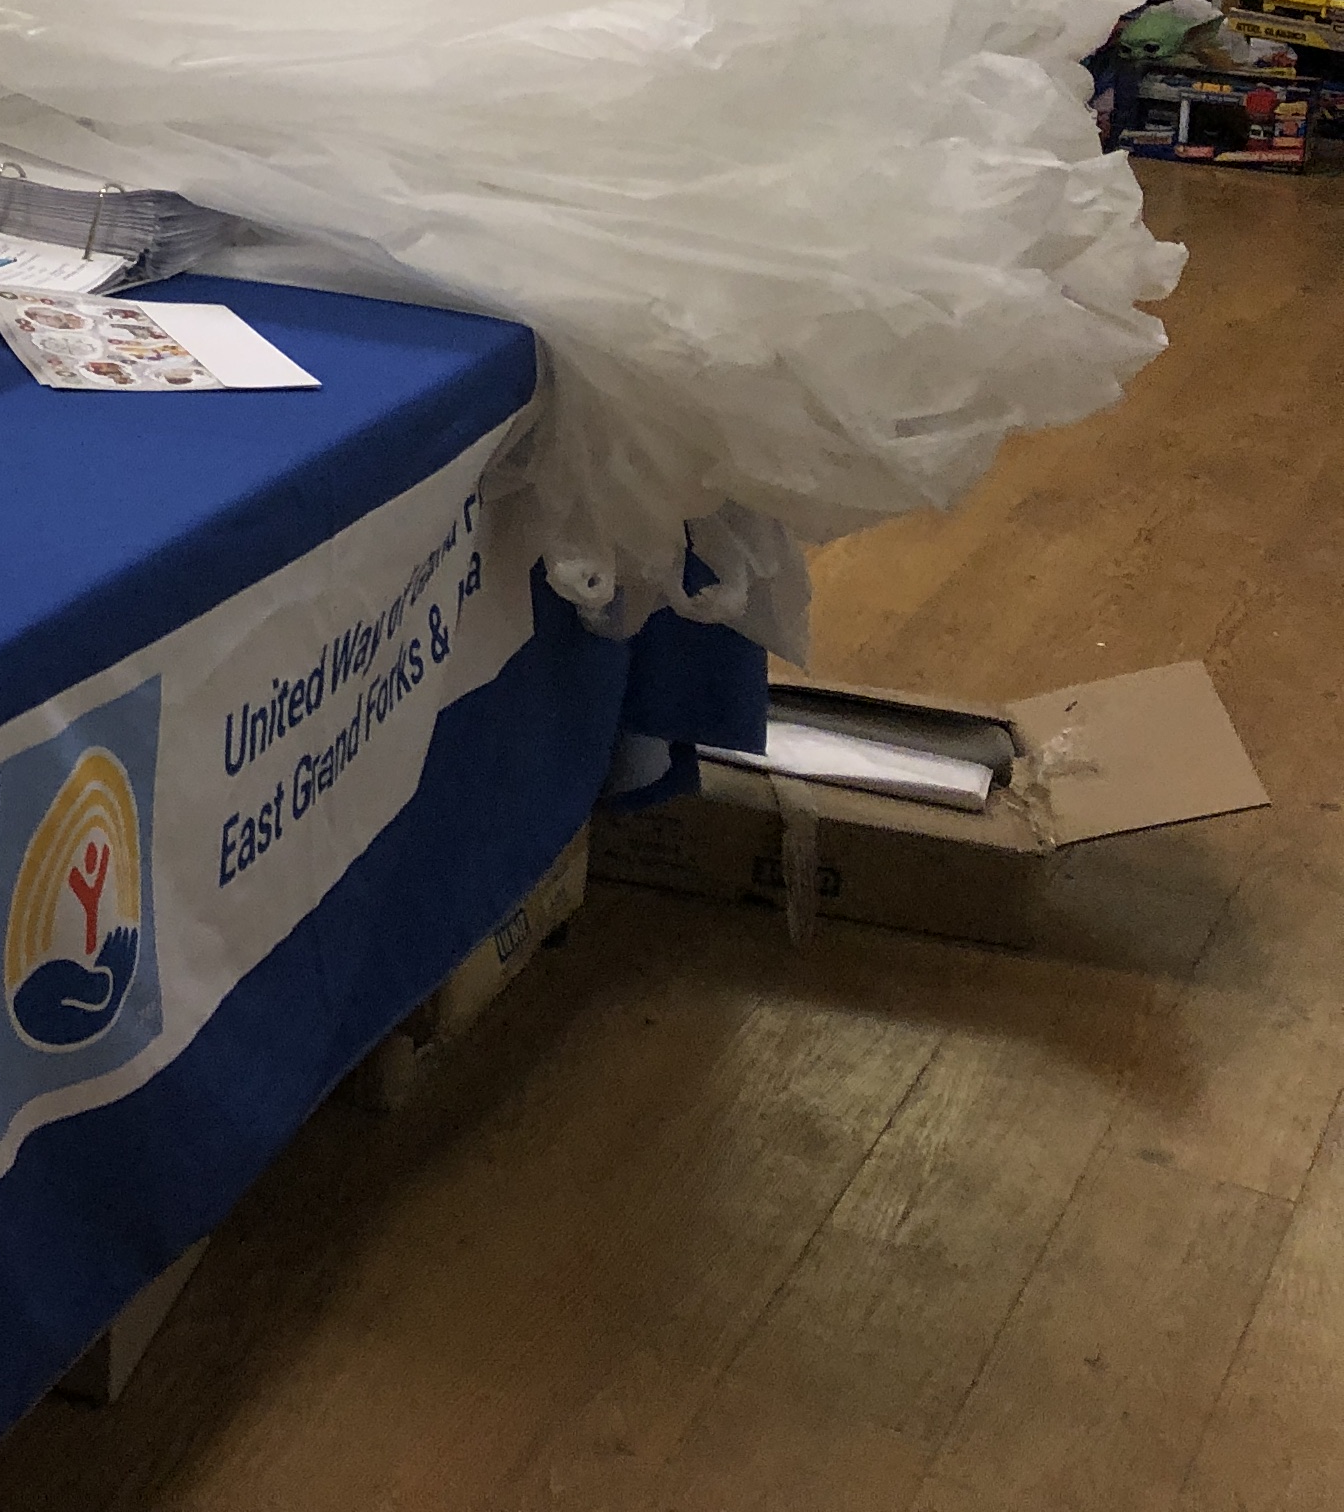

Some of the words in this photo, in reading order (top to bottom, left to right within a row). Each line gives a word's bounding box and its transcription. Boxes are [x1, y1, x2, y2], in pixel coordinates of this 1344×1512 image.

[219, 780, 285, 888] East
[292, 692, 363, 821] Grand
[365, 636, 425, 742] Forks
[428, 603, 450, 664] &
[225, 643, 327, 778] United
[330, 611, 386, 696] Way
